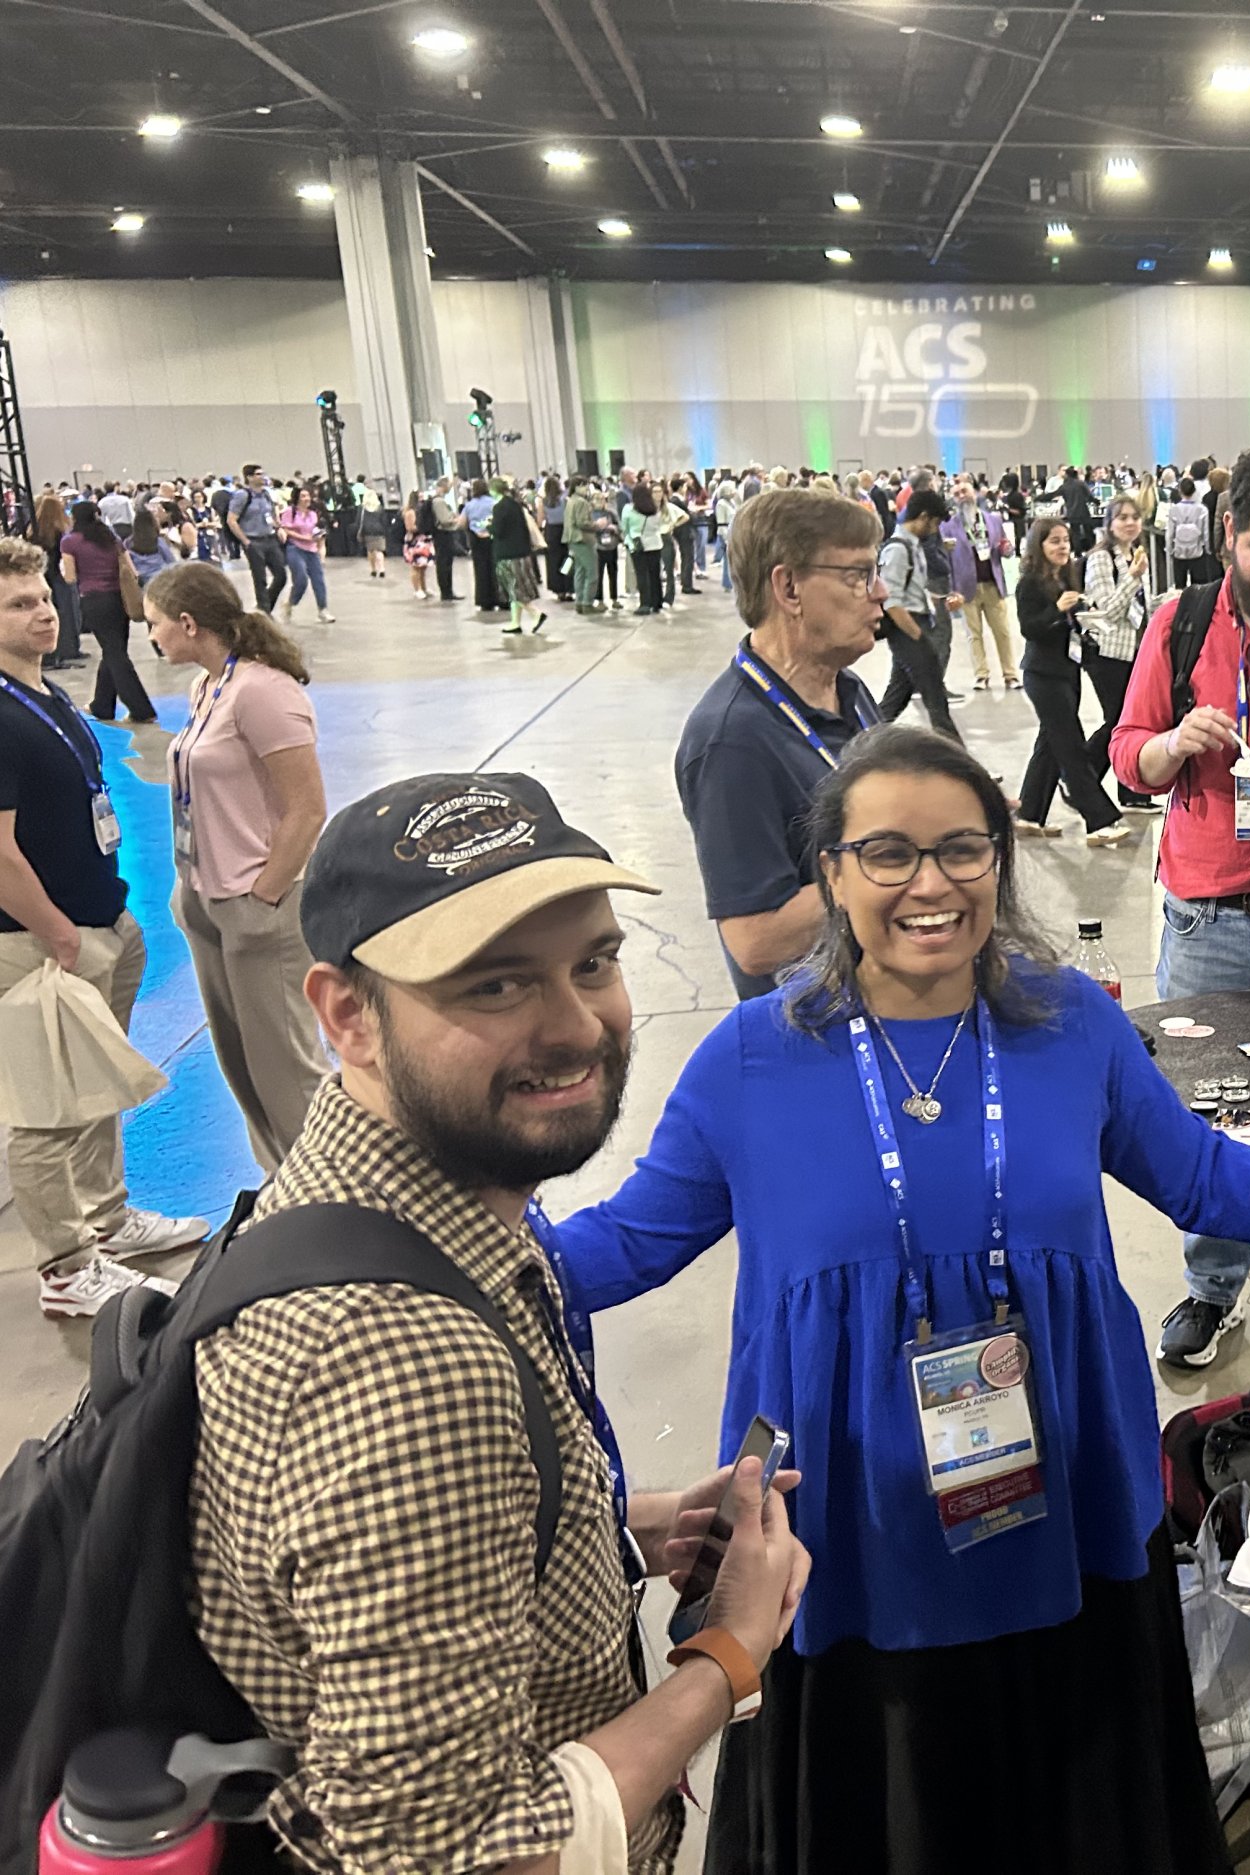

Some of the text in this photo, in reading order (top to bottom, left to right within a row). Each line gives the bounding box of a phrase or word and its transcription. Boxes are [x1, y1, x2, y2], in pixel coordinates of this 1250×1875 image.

[855, 294, 1036, 316] CELEBRATING
[855, 321, 987, 381] ACS
[855, 382, 1039, 438] 150
[923, 1360, 942, 1375] ACS
[937, 1390, 1009, 1416] MONICA ARROYO
